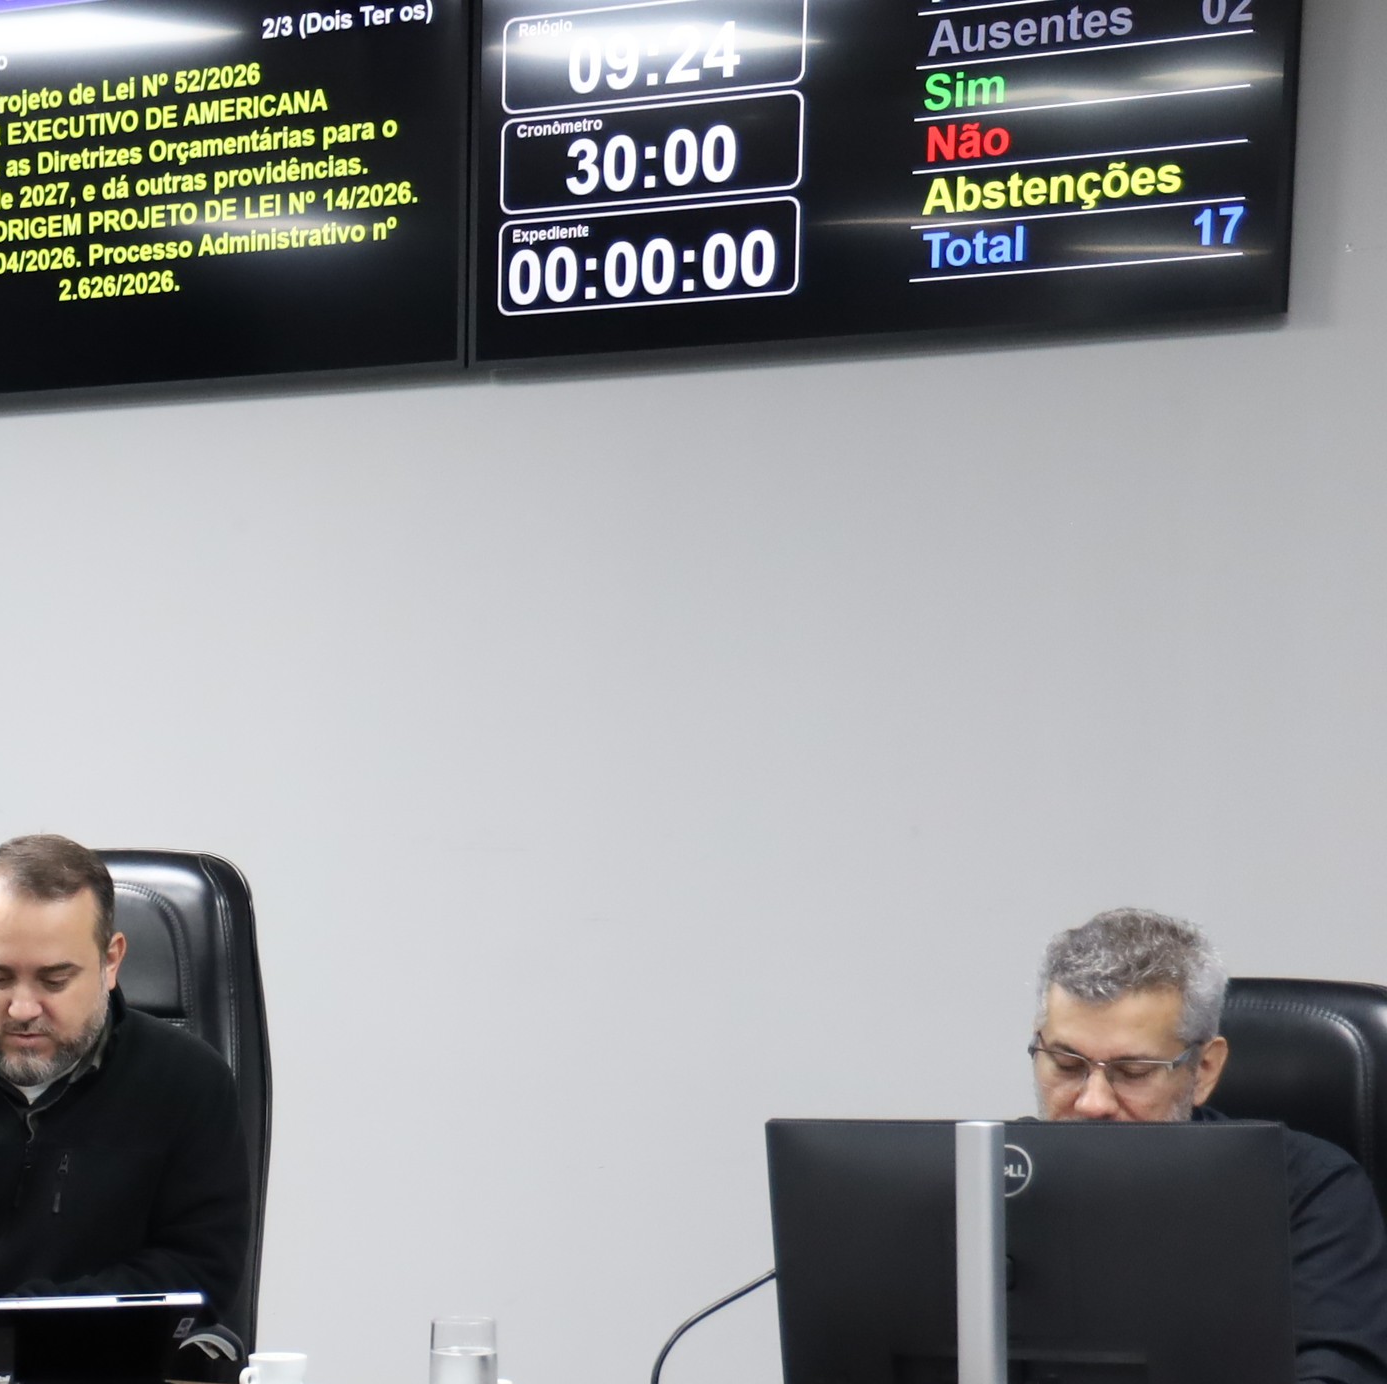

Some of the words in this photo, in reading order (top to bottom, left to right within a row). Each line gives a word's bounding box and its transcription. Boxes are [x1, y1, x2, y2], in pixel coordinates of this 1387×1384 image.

[262, 16, 293, 39] 2/3
[299, 10, 353, 39] (Dois
[360, 5, 394, 26] Ter
[518, 18, 574, 39] Relógio
[927, 4, 1134, 57] Ausentes
[568, 20, 740, 94] 09:24
[68, 81, 95, 107] de
[102, 75, 135, 103] Lei
[141, 72, 168, 100] Nº
[174, 62, 260, 95] 52/2026
[923, 71, 1006, 112] Sim
[6, 107, 139, 145] EXECUTIVO
[145, 103, 178, 131] DE
[183, 88, 328, 129] AMERICANA
[515, 116, 603, 138] Cronômetro
[924, 121, 1011, 161] Não
[5, 160, 31, 178] as
[37, 143, 143, 175] Diretrizes
[148, 125, 315, 168] Orçamentárias
[322, 119, 375, 150] para
[381, 119, 398, 138] o
[565, 124, 737, 197] 30:00
[19, 180, 77, 212] 2027,
[82, 183, 95, 202] e
[101, 171, 130, 200] dá
[135, 169, 207, 197] outras
[213, 154, 368, 194] providências.
[88, 200, 198, 235] PROJETO
[204, 194, 238, 223] DE
[244, 190, 282, 219] LEI
[288, 186, 315, 216] Nº
[322, 179, 419, 212] 14/2026.
[921, 160, 1183, 217] Abstenções
[88, 234, 193, 267] Processo
[198, 220, 366, 256] Administrativo
[372, 215, 397, 241] nº
[512, 224, 590, 244] Expediente
[923, 226, 1026, 269] Total
[1192, 206, 1245, 248] 17
[59, 267, 181, 301] 2.626/2026.
[509, 231, 775, 305] 00:00:00
